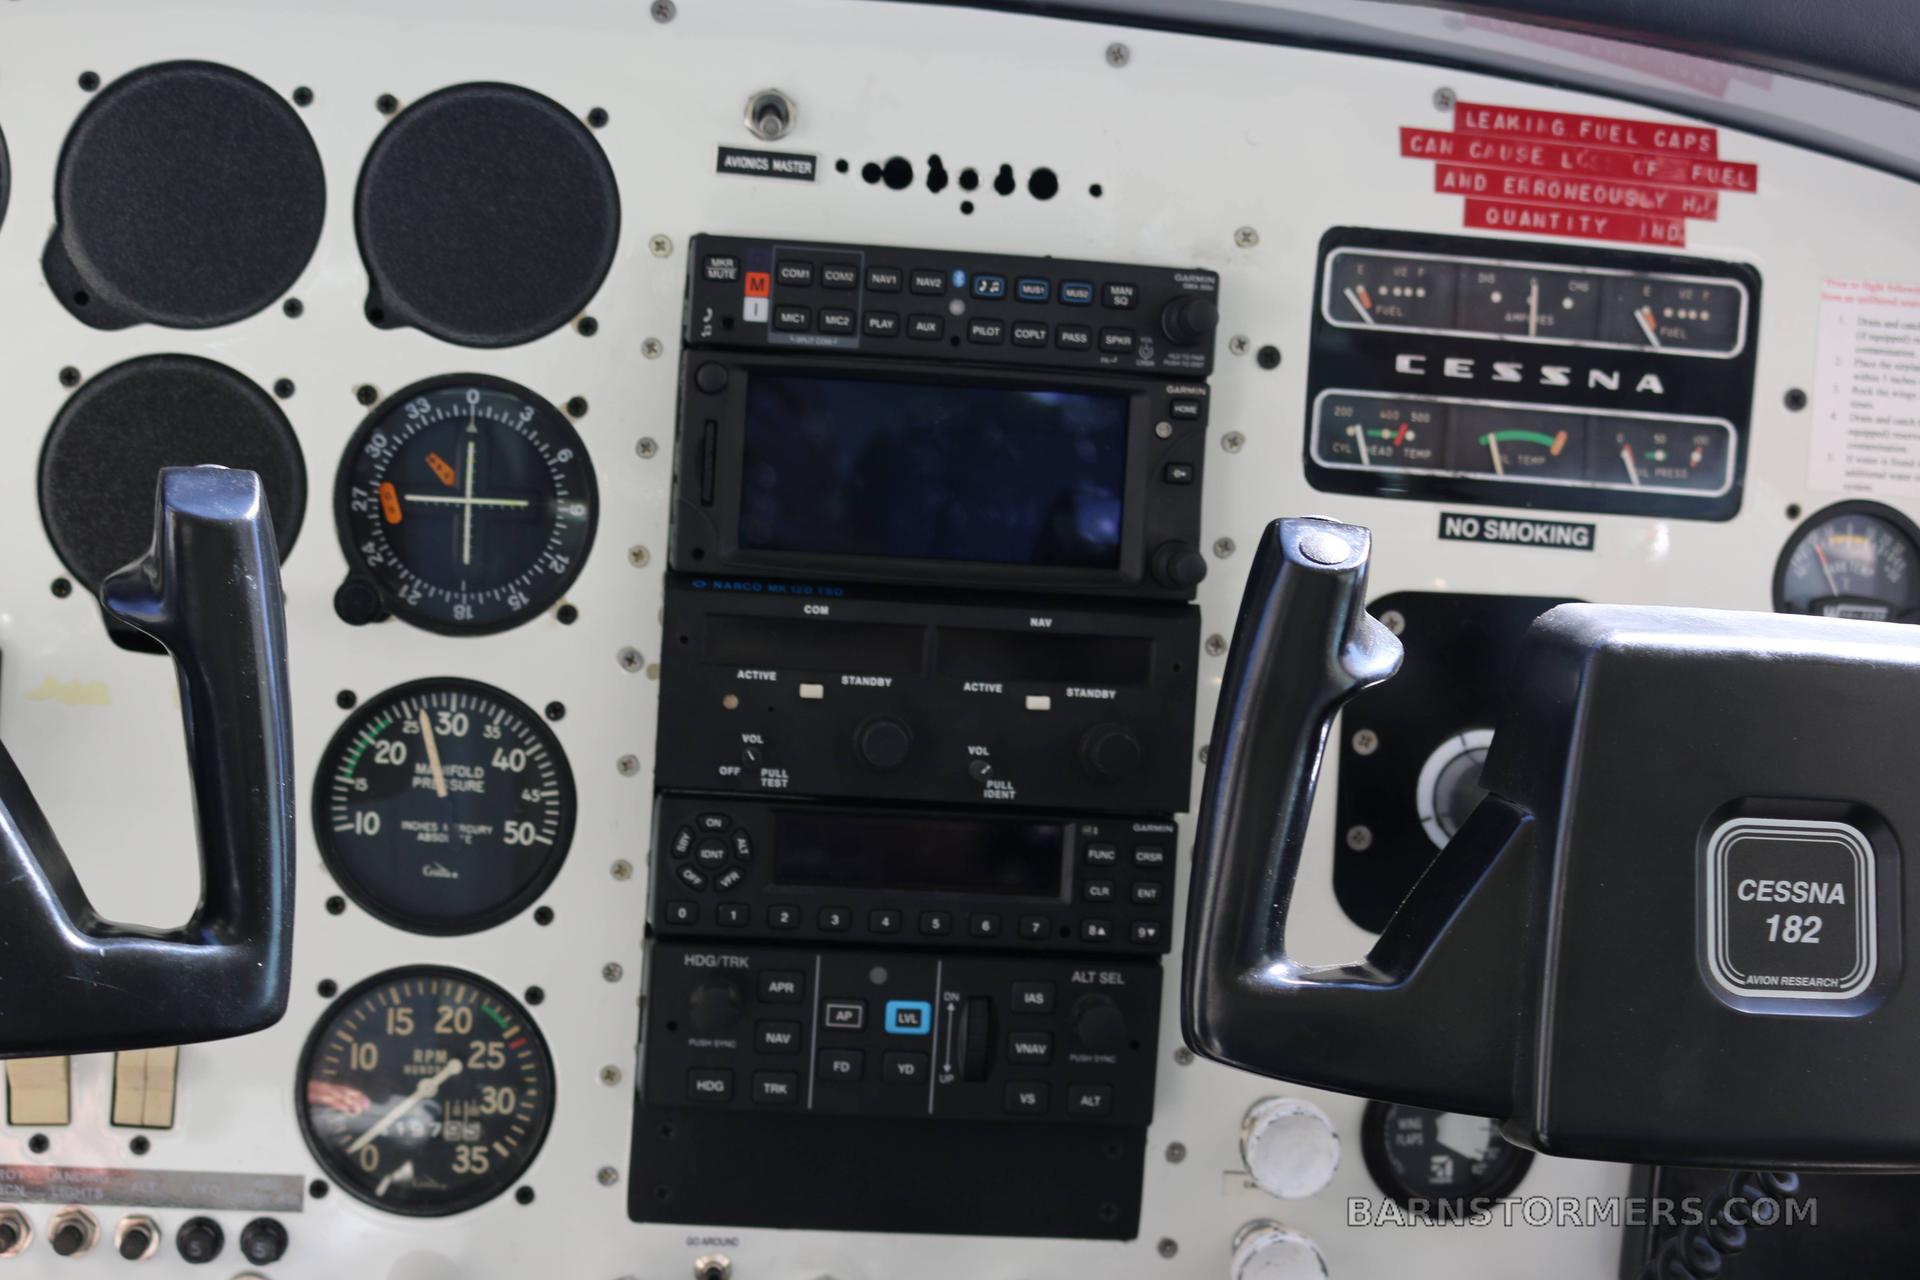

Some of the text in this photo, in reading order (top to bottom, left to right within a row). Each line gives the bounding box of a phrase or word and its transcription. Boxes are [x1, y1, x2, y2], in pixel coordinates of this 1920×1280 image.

[1466, 112, 1711, 151] LEAKING FUEL CAPS
[724, 155, 812, 174] AVIONICS MASTER
[1411, 136, 1453, 155] CAN
[1692, 164, 1749, 188] FUEL
[1444, 172, 1488, 191] AND
[1486, 207, 1680, 242] QUANTITY IND
[711, 257, 734, 267] MKR
[708, 269, 736, 280] MUTE
[781, 268, 811, 280] COM1
[825, 271, 854, 282] COM2
[871, 273, 897, 285] NAV1
[916, 276, 942, 288] NAV2
[1110, 286, 1133, 296] MAN
[1113, 296, 1128, 306] SQ
[1375, 305, 1403, 317] FUEL
[781, 312, 805, 323] MIC1
[825, 315, 850, 327] MIC2
[869, 318, 893, 329] PLAY
[916, 321, 936, 332] AUX
[972, 325, 1000, 337] PILOT
[1014, 328, 1046, 340] COPLT
[1062, 332, 1087, 343] PASS
[1660, 326, 1688, 340] FUEL
[1105, 335, 1132, 346] SPKR
[1395, 353, 1665, 394] CESSNA
[1166, 385, 1206, 395] GARMIN
[465, 388, 480, 406] 0
[405, 396, 432, 420] 33
[518, 405, 535, 423] 3
[1174, 405, 1197, 414] HOME
[364, 432, 388, 459] 30
[556, 448, 574, 464] 6
[1403, 447, 1432, 460] TEMP
[1517, 454, 1546, 466] TEMP
[1654, 468, 1688, 480] PRESS
[351, 486, 368, 512] 27
[1445, 516, 1590, 549] NO SMOKING
[361, 541, 384, 567] 24
[549, 554, 571, 575] 12
[713, 581, 762, 592] NARCO
[398, 583, 422, 606] 21
[507, 590, 530, 611] 15
[453, 604, 475, 621] 18
[804, 604, 829, 615] COM
[1030, 618, 1052, 627] NAV
[737, 670, 777, 681] ACTIVE
[841, 675, 892, 687] STANDBY
[963, 682, 1003, 693] ACTIVE
[1066, 688, 1116, 699] STANDBY
[402, 719, 420, 735] 25
[435, 711, 469, 737] 30
[483, 725, 501, 740] 35
[742, 734, 764, 744] VOL
[374, 740, 407, 765] 20
[968, 746, 990, 756] VOL
[491, 747, 527, 772] 40
[719, 766, 741, 776] OFF
[761, 768, 789, 778] PULL
[354, 778, 368, 791] 15
[761, 778, 788, 788] TEST
[987, 780, 1014, 790] PULL
[521, 788, 541, 802] 45
[983, 790, 1016, 799] IDENT
[355, 811, 381, 836] 10
[706, 818, 722, 827] ON
[1133, 823, 1174, 834] GARMIN
[504, 820, 536, 846] 50
[700, 850, 724, 859] IDNT
[1088, 849, 1115, 861] FUNC
[1089, 886, 1110, 896] CLR
[1137, 888, 1157, 899] ENT
[1737, 878, 1845, 905] CESSNA
[678, 908, 687, 919] 0
[731, 910, 738, 920] 1
[780, 912, 789, 923] 2
[831, 914, 840, 925] 3
[881, 916, 890, 927] 4
[932, 918, 940, 929] 5
[982, 920, 990, 931] 6
[1032, 922, 1040, 932] 7
[1088, 925, 1097, 936] 8
[1138, 927, 1147, 938] 9
[1765, 914, 1822, 944] 182
[684, 954, 749, 968] HDG/TRK
[1072, 971, 1125, 985] ALT SEL
[1746, 975, 1839, 988] AVION RESEARCH
[768, 982, 794, 993] APR
[944, 992, 959, 1002] DN
[1024, 993, 1044, 1003] IAS
[386, 1006, 414, 1036] 15
[434, 1005, 473, 1035] 20
[836, 1011, 853, 1021] AP
[898, 1013, 918, 1024] LVL
[765, 1033, 791, 1044] NAV
[1015, 1043, 1046, 1054] VNAV
[350, 1043, 379, 1071] 10
[413, 1049, 448, 1063] RPM
[467, 1040, 506, 1070] 25
[833, 1061, 850, 1072] FD
[898, 1064, 914, 1075] YD
[939, 1074, 954, 1084] UP
[697, 1080, 724, 1092] HDG
[764, 1083, 787, 1094] TRK
[480, 1086, 516, 1115] 30
[1020, 1094, 1036, 1104] VS
[1081, 1096, 1101, 1106] ALT
[359, 1144, 380, 1172] 0
[452, 1144, 489, 1174] 35
